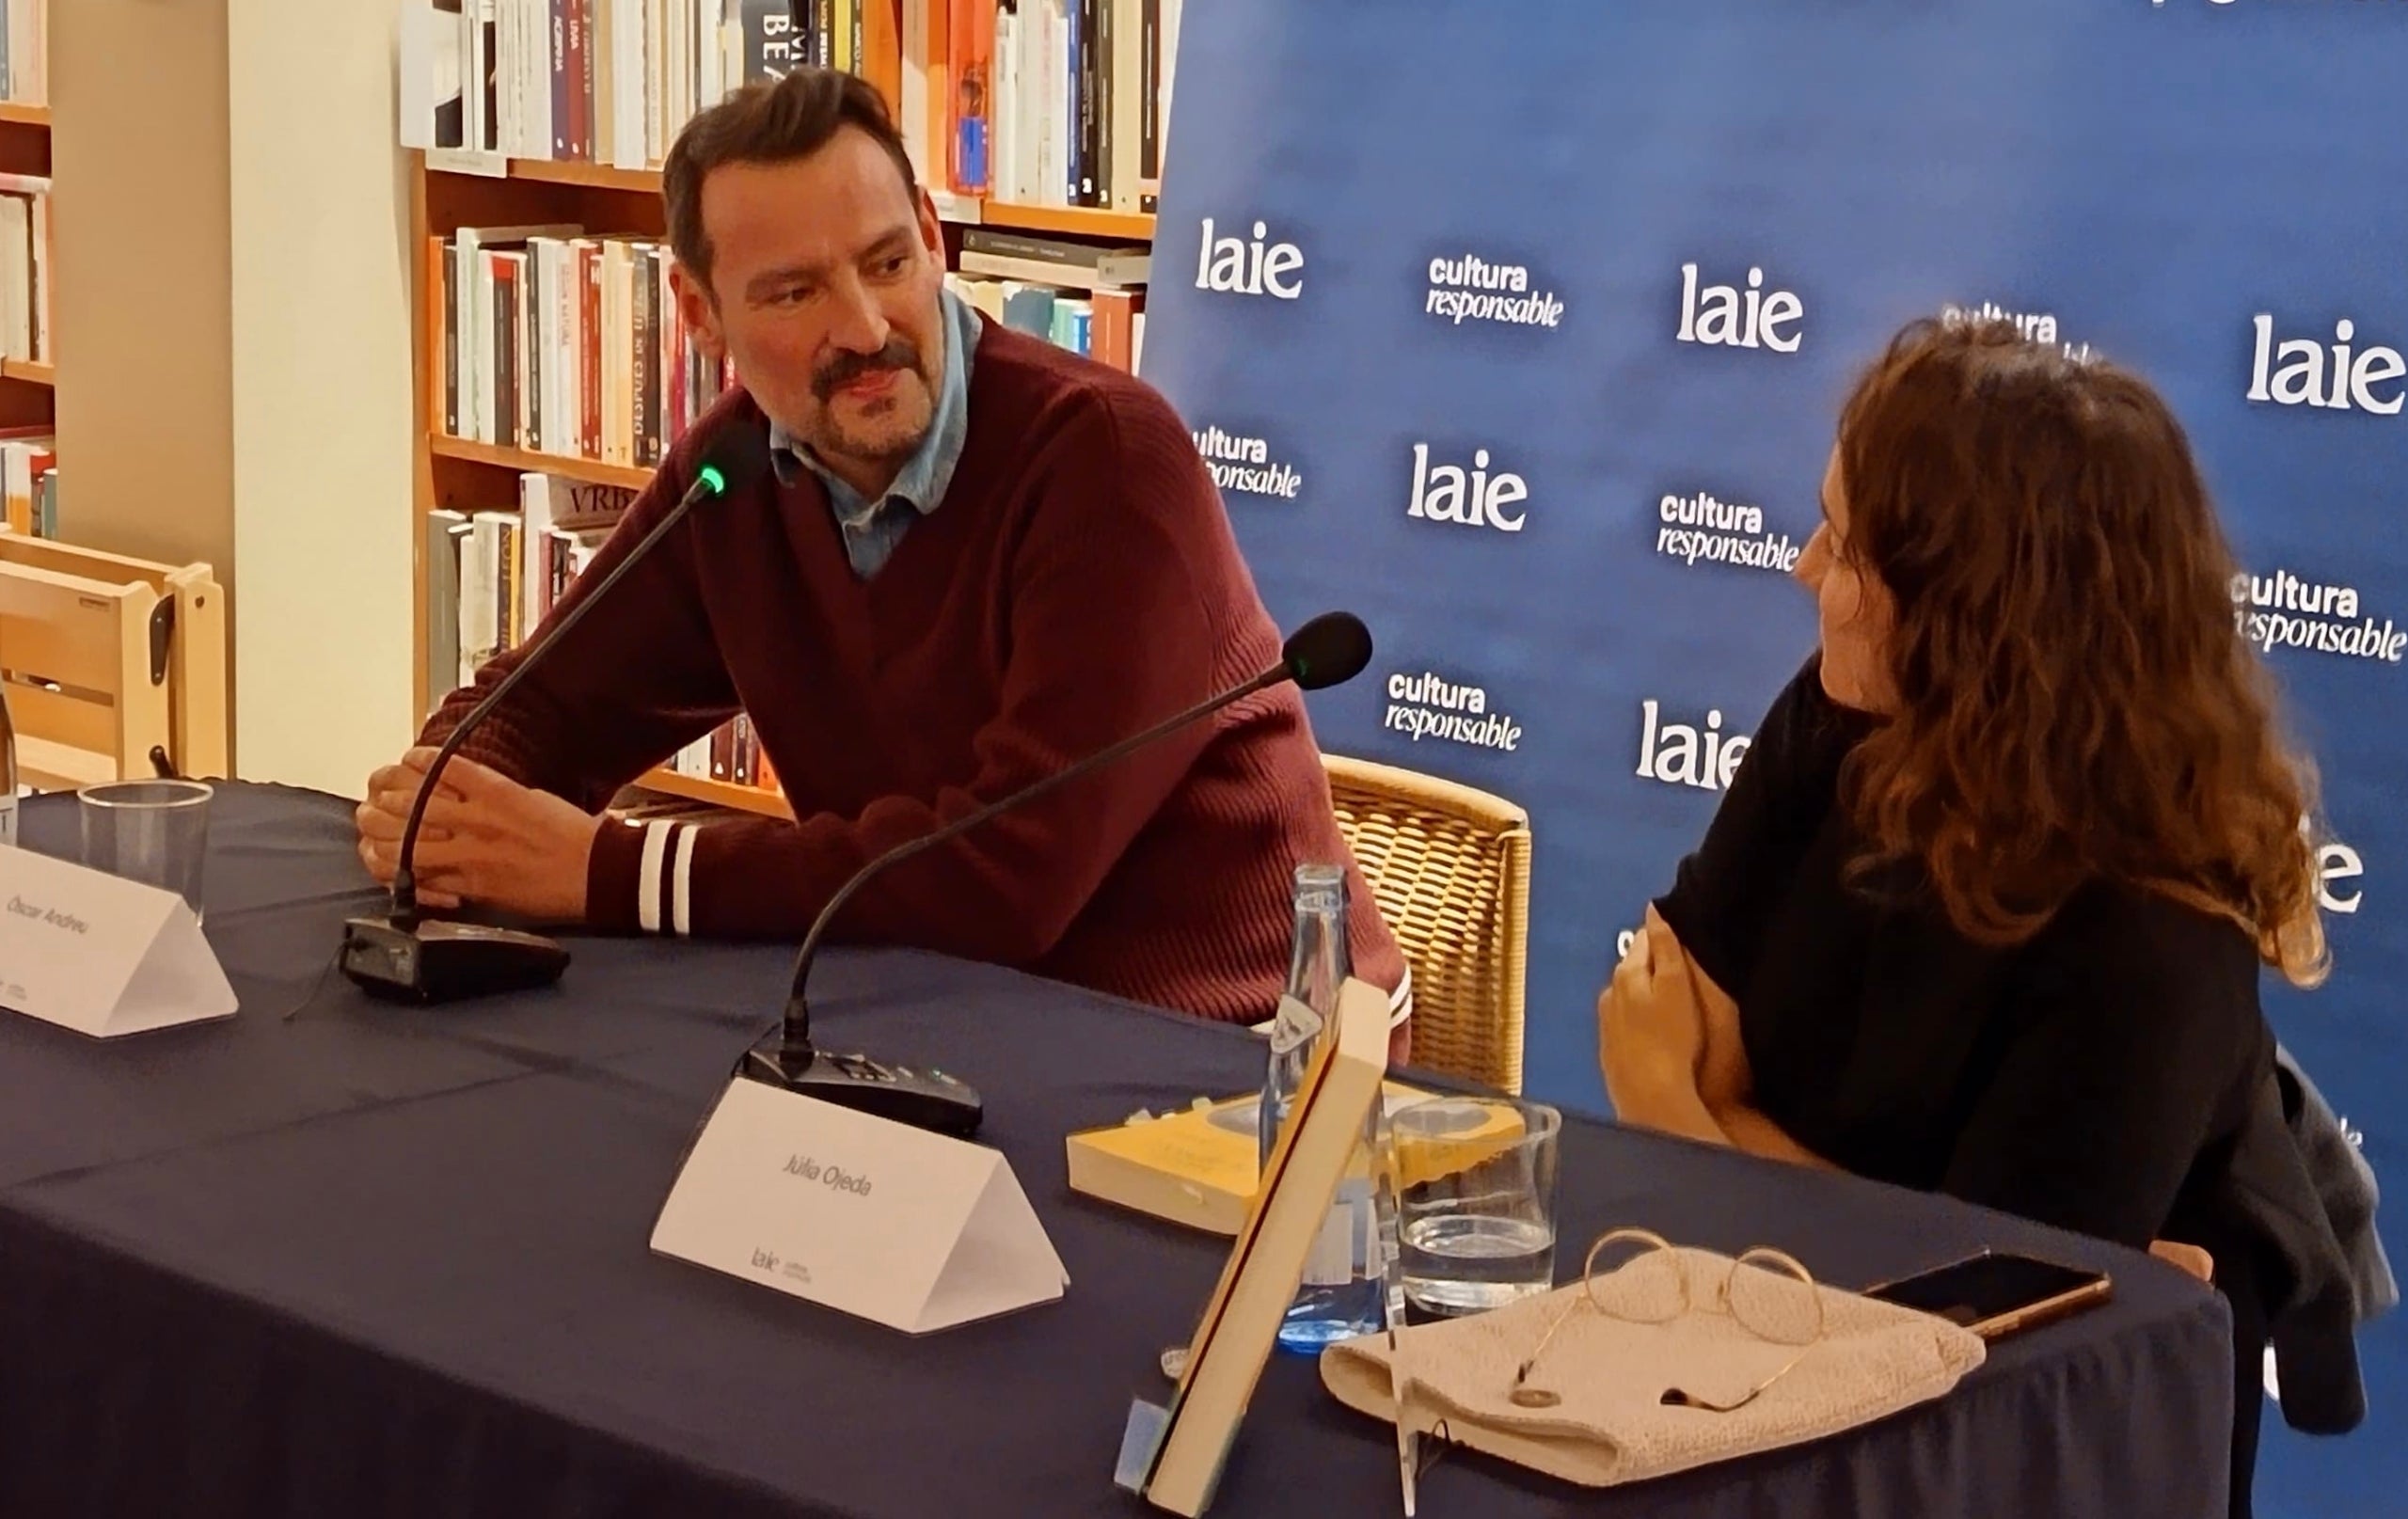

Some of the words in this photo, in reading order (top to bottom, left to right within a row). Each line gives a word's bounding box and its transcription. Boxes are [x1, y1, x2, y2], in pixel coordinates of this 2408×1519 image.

[1196, 217, 1304, 298] laie
[1429, 255, 1529, 292] cultura
[1425, 289, 1564, 327] responsable
[1676, 263, 1804, 353] laie
[2246, 313, 2407, 415] laie
[1191, 424, 1268, 464] ultura
[1205, 460, 1302, 498] onsable
[1407, 443, 1529, 531] laie
[1659, 492, 1764, 533] cultura
[1656, 526, 1800, 572] responsable
[1388, 672, 1486, 713] cultura
[1385, 704, 1522, 752] responsable
[1635, 700, 1752, 791] laie
[823, 1165, 872, 1197] Ojeda
